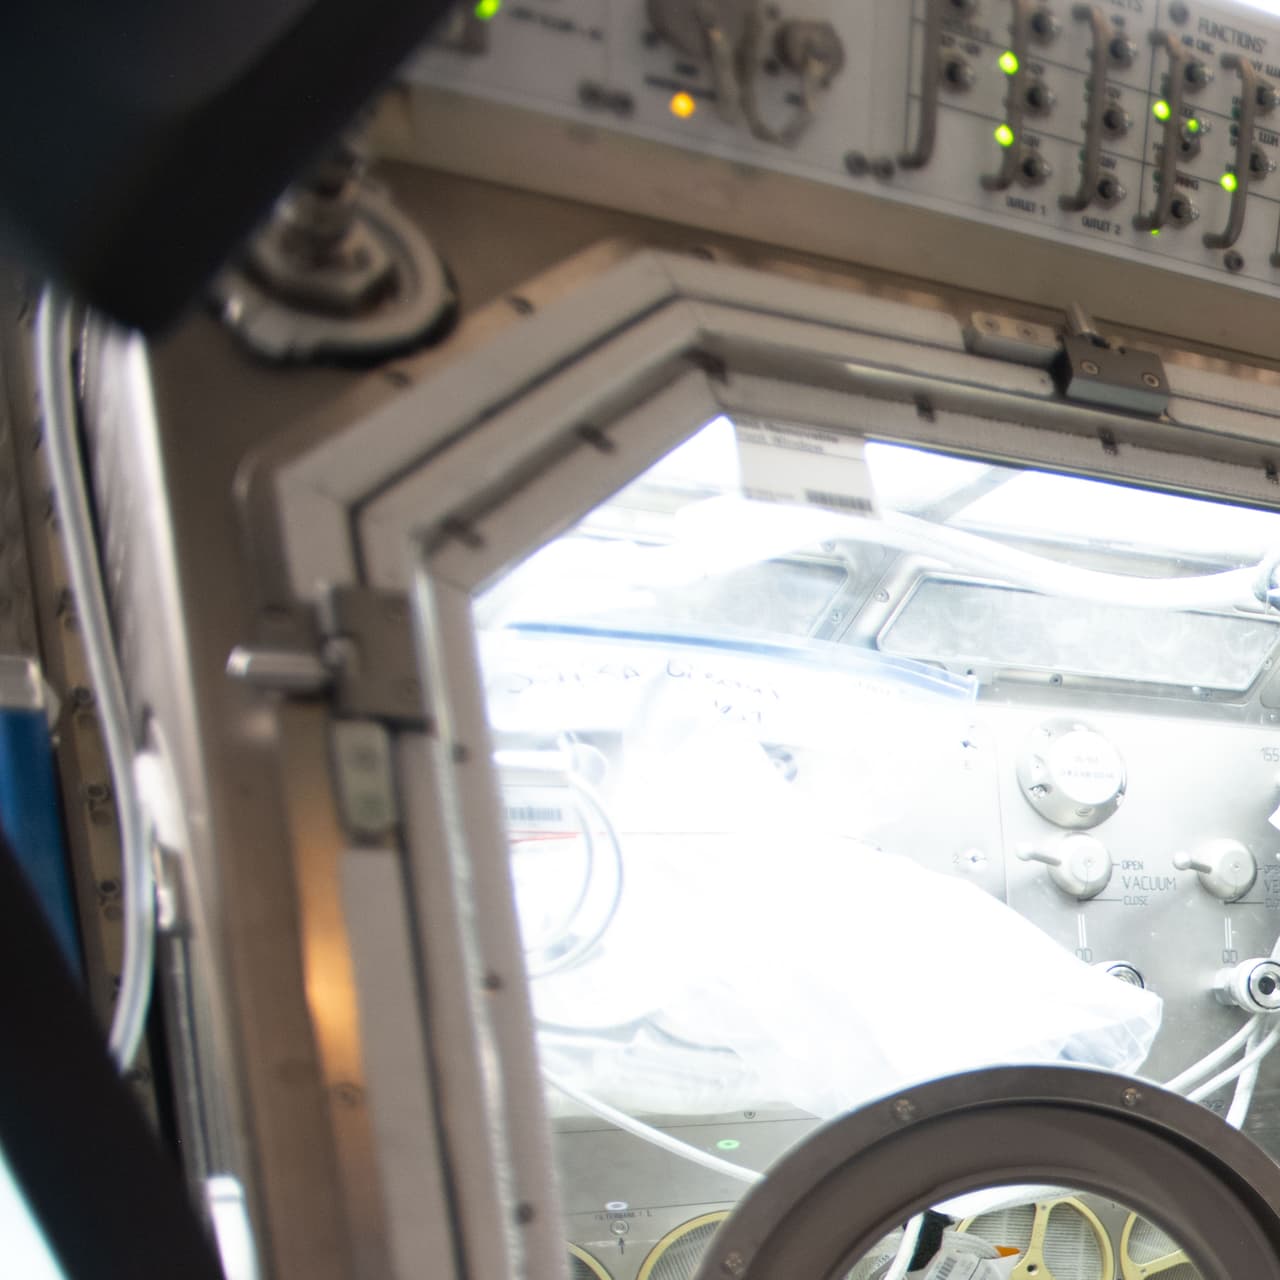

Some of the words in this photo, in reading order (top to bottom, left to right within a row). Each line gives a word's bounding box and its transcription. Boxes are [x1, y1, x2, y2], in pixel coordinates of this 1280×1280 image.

[1121, 859, 1144, 870] OPEN
[1121, 875, 1177, 891] VACUUM
[1123, 895, 1150, 906] CLOSE
